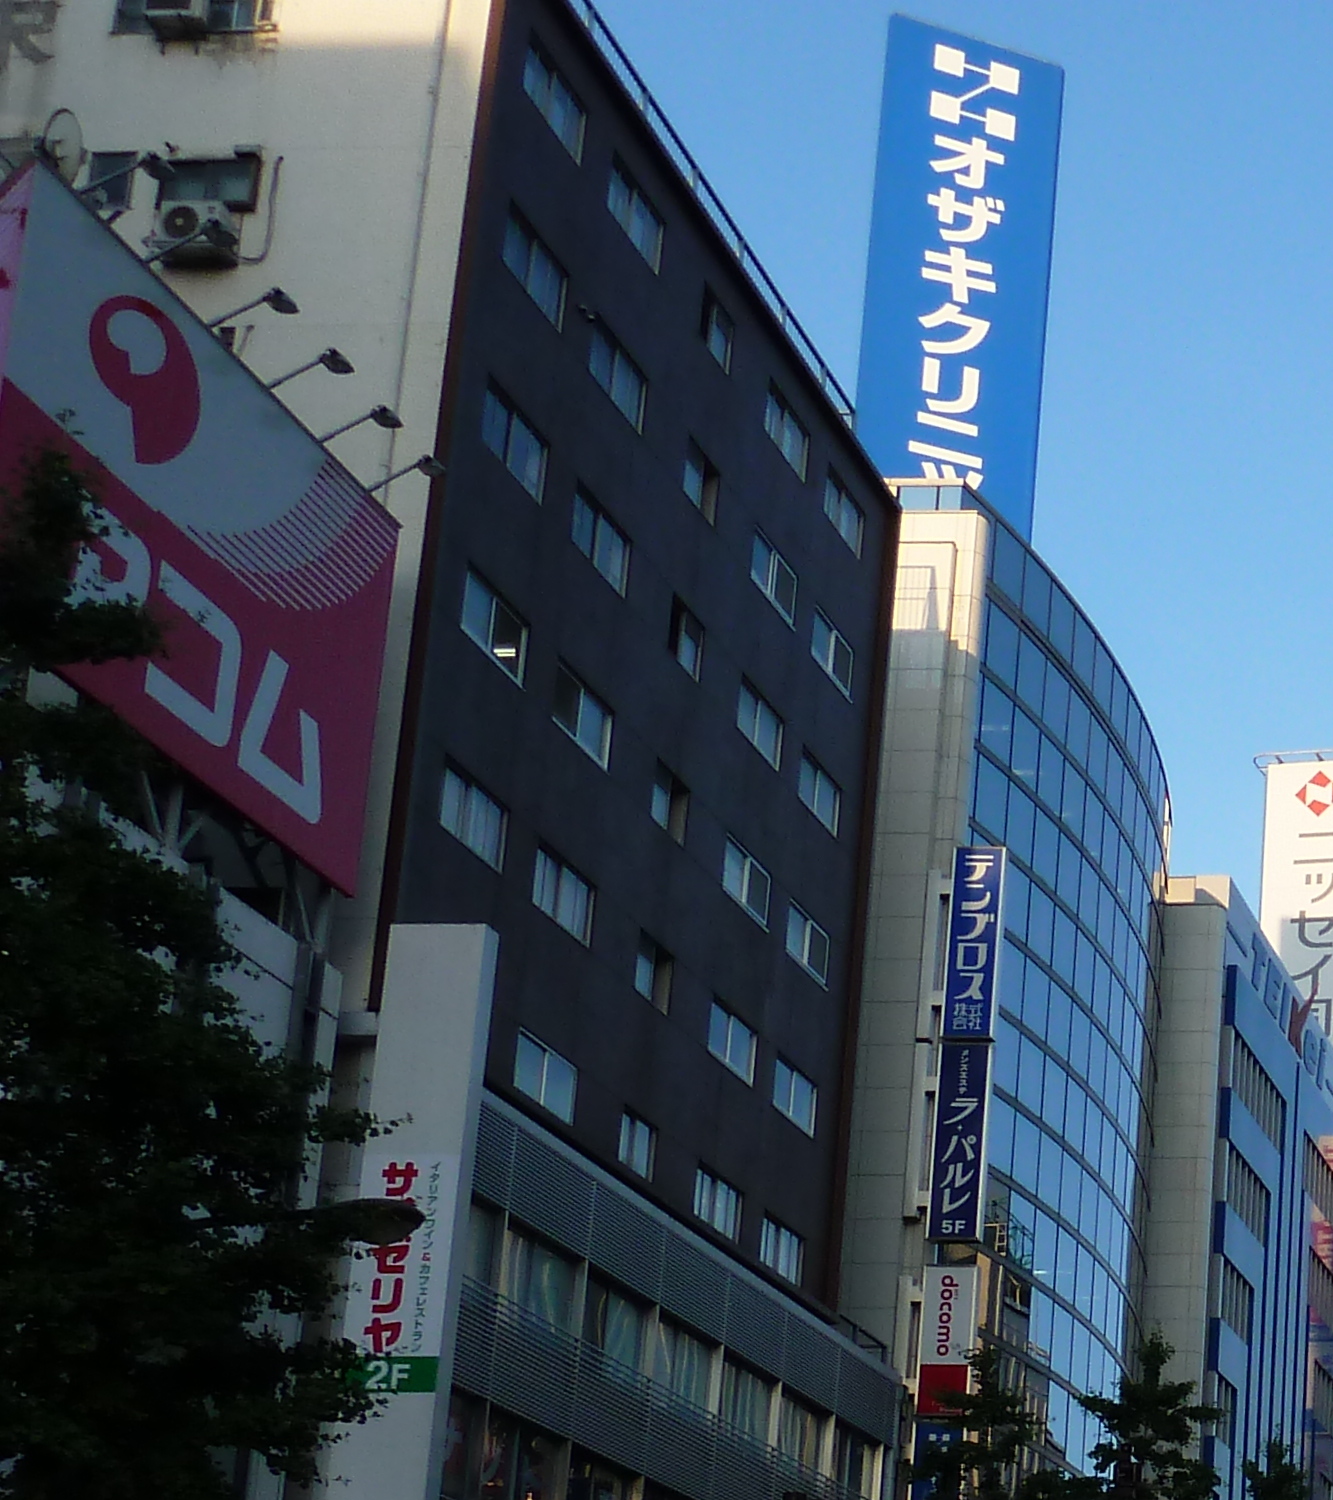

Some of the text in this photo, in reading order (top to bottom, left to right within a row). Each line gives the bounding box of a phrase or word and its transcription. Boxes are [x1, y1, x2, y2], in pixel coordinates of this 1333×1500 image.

[953, 853, 996, 1001] テンブロス
[940, 1097, 980, 1214] ラ・パルレ
[363, 1161, 419, 1354] サゼリヤ
[940, 1219, 966, 1235] 5F
[936, 1274, 959, 1357] docomo
[365, 1360, 412, 1391] 2F
